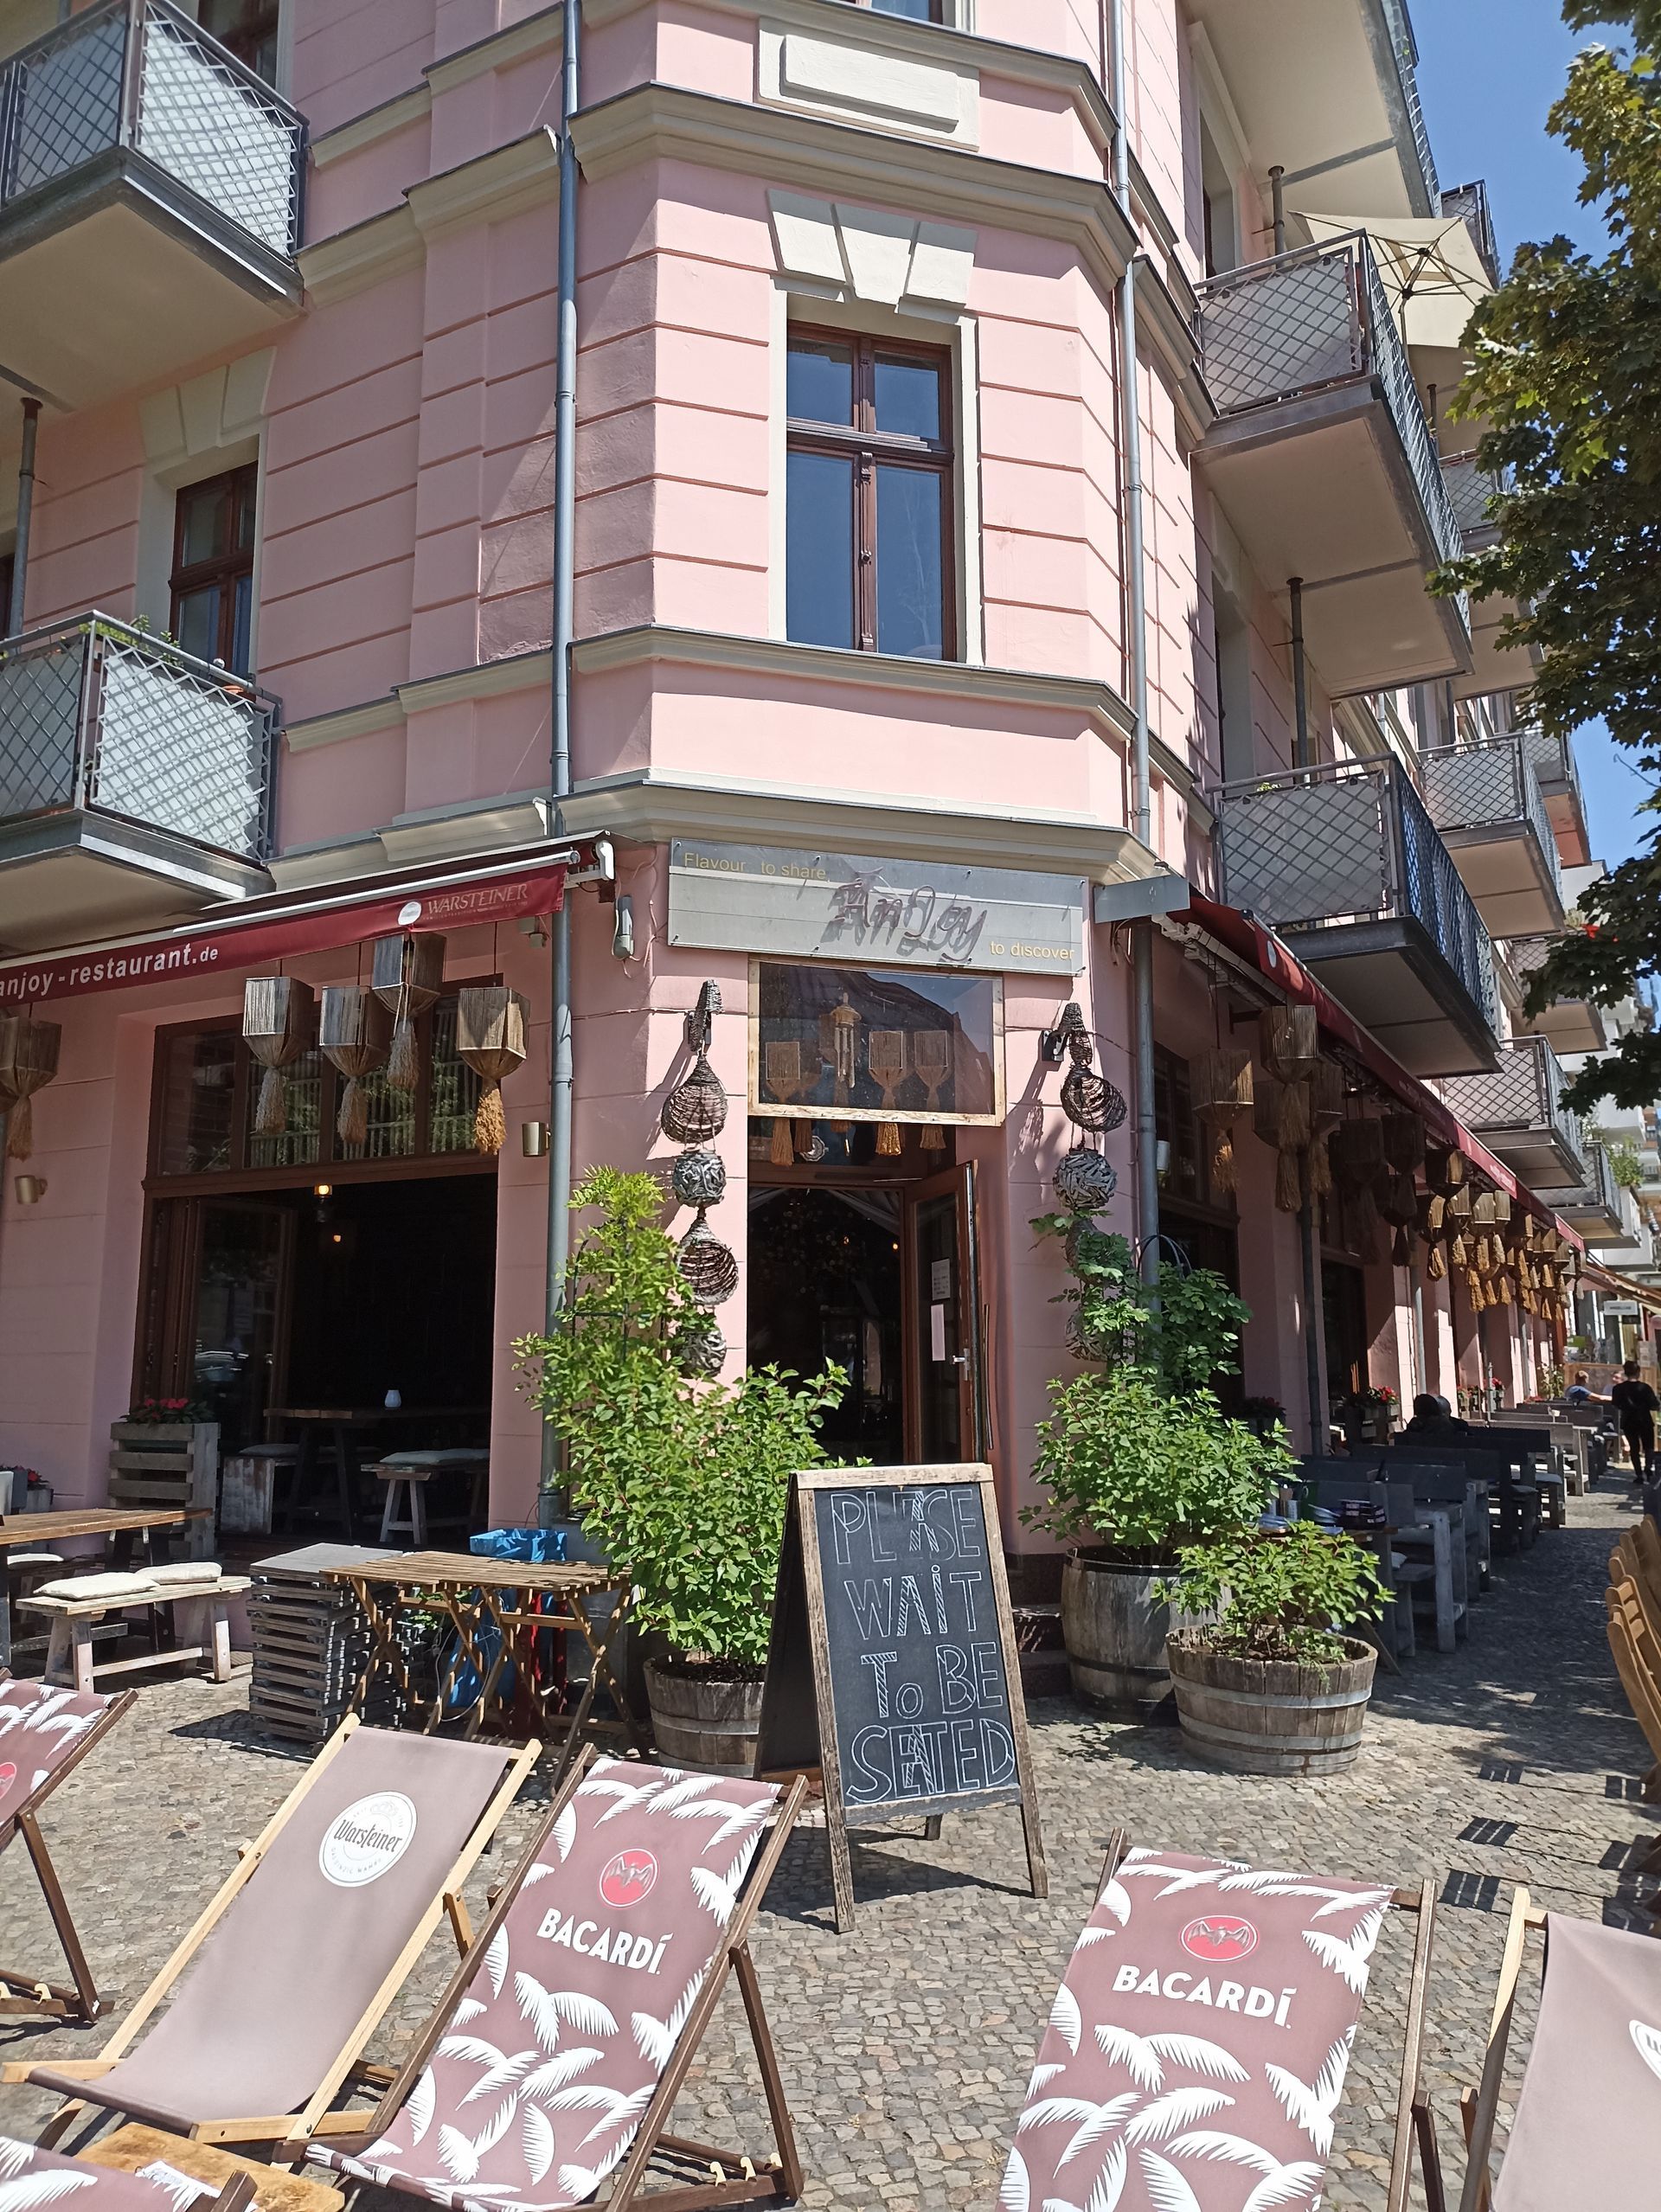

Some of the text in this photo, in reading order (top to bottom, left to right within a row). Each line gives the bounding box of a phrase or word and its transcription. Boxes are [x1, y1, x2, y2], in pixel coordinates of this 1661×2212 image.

[683, 851, 747, 873] Flavour
[761, 861, 776, 876] to
[426, 883, 529, 914] WARSTEINER
[990, 940, 1075, 960] to discover
[935, 1641, 1004, 1715] BE
[845, 1717, 1016, 1804] SEATED
[333, 1818, 403, 1853] Warsteiner
